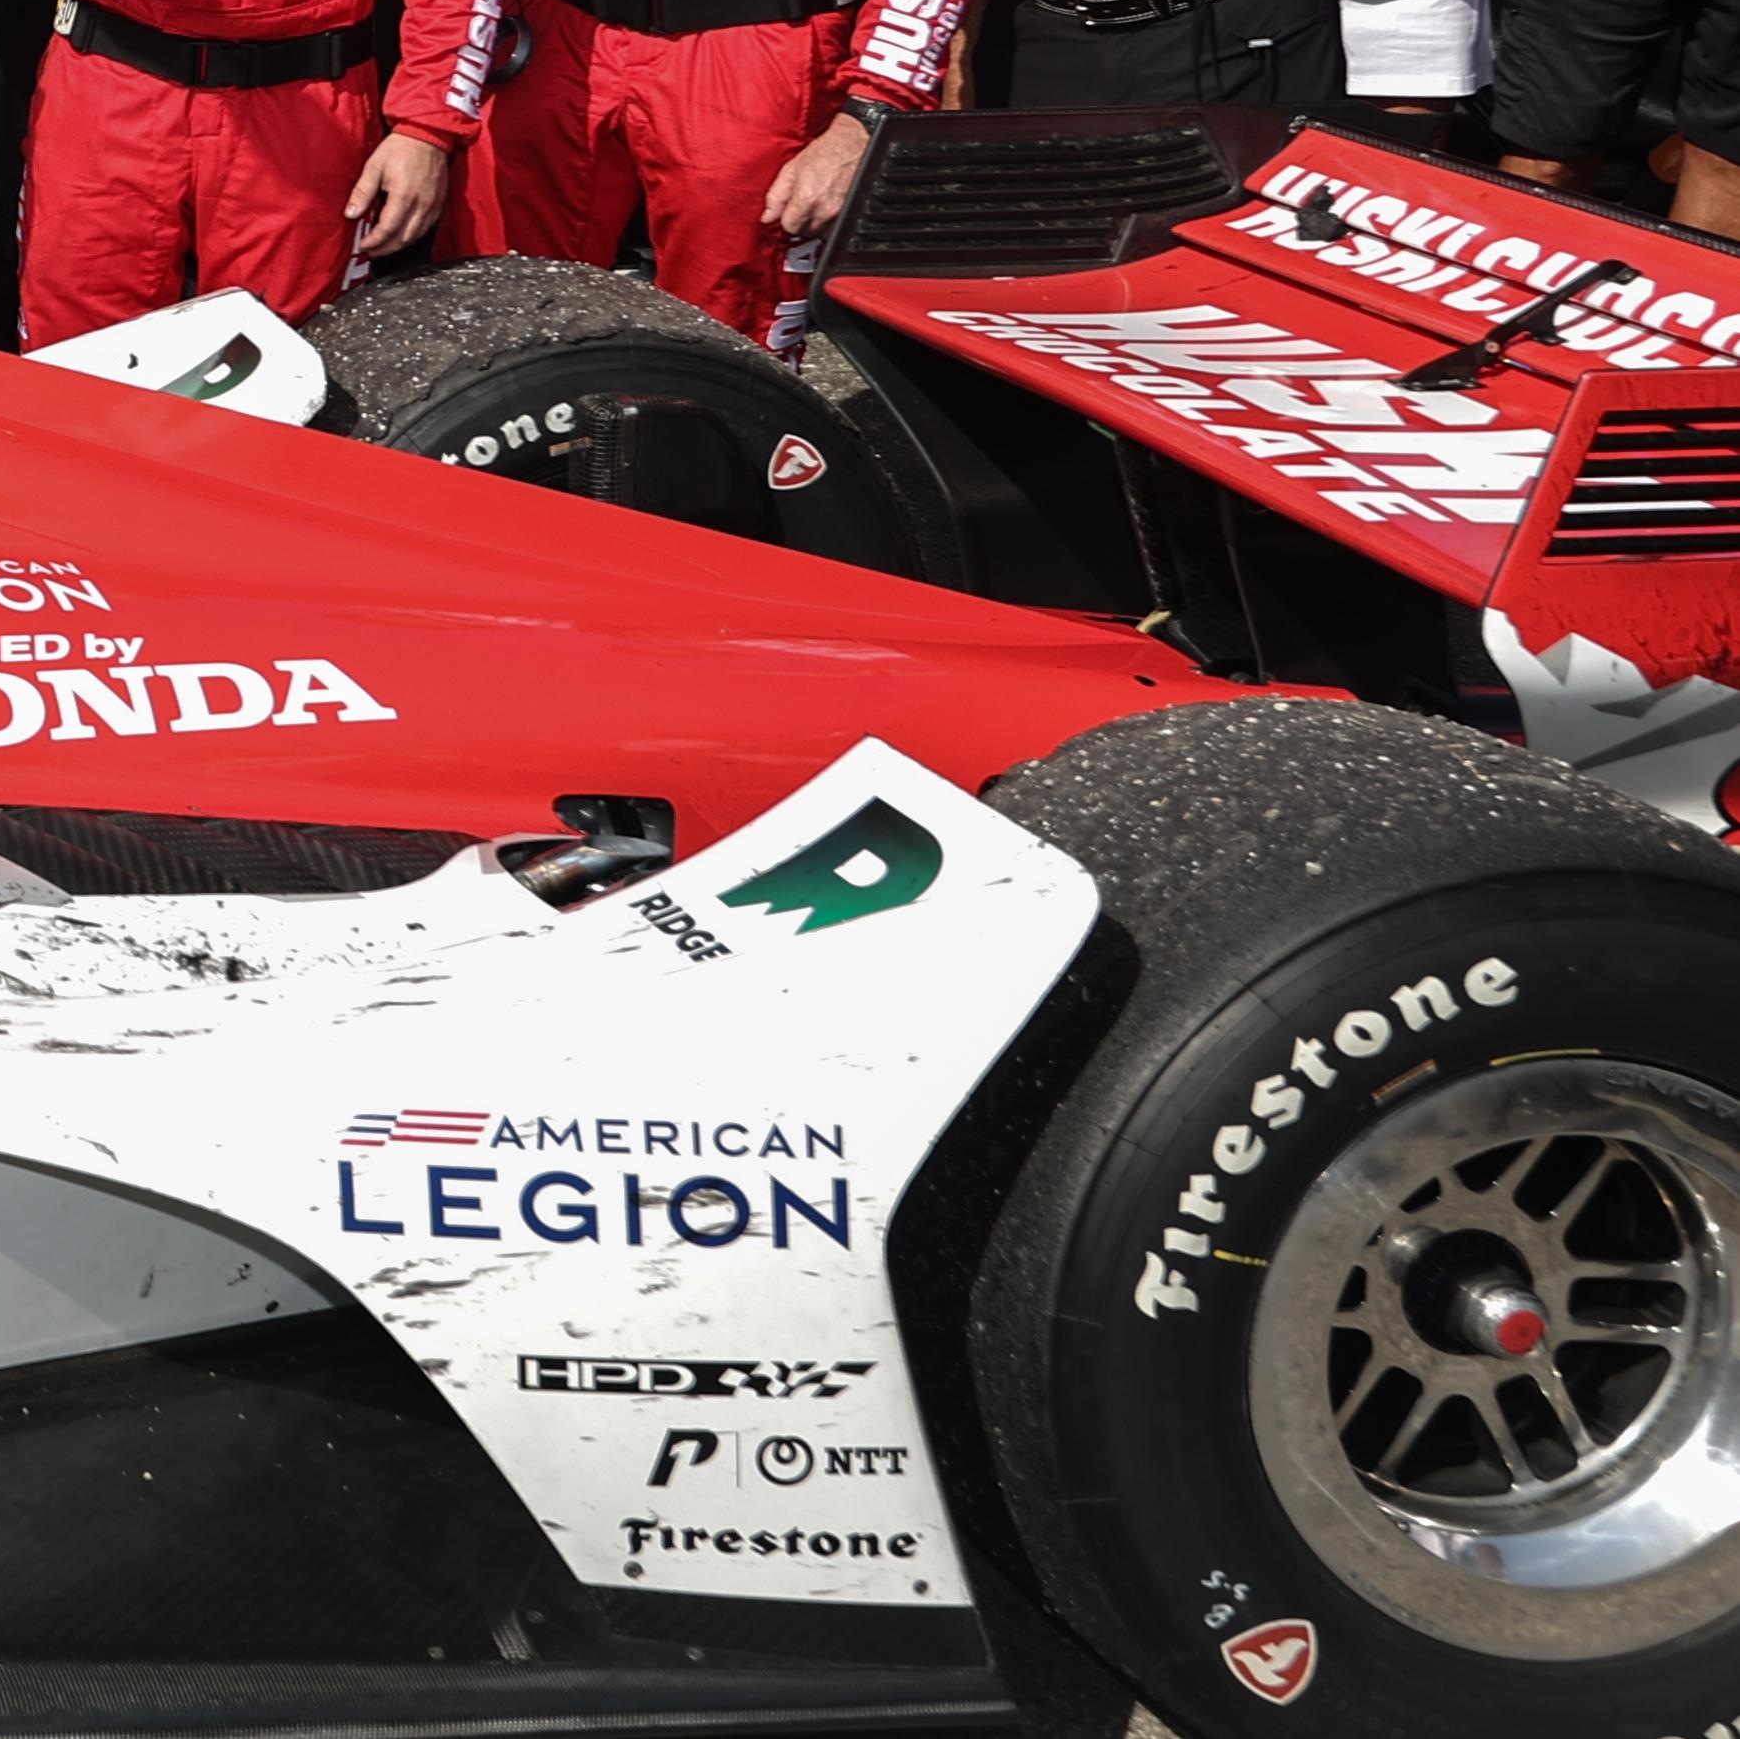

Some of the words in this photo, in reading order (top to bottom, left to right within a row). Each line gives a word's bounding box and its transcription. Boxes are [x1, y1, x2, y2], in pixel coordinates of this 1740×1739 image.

[926, 309, 1456, 524] CHOCOLATE
[1007, 304, 1555, 525] HUSKI
[84, 631, 144, 665] by
[628, 891, 734, 966] RIDGE
[489, 1115, 845, 1160] AMERICAN
[1134, 956, 1521, 1322] Firestone
[337, 1160, 851, 1251] LEGION
[523, 1358, 698, 1394] HPD
[823, 1445, 909, 1476] NTT
[619, 1516, 921, 1560] Firestone
